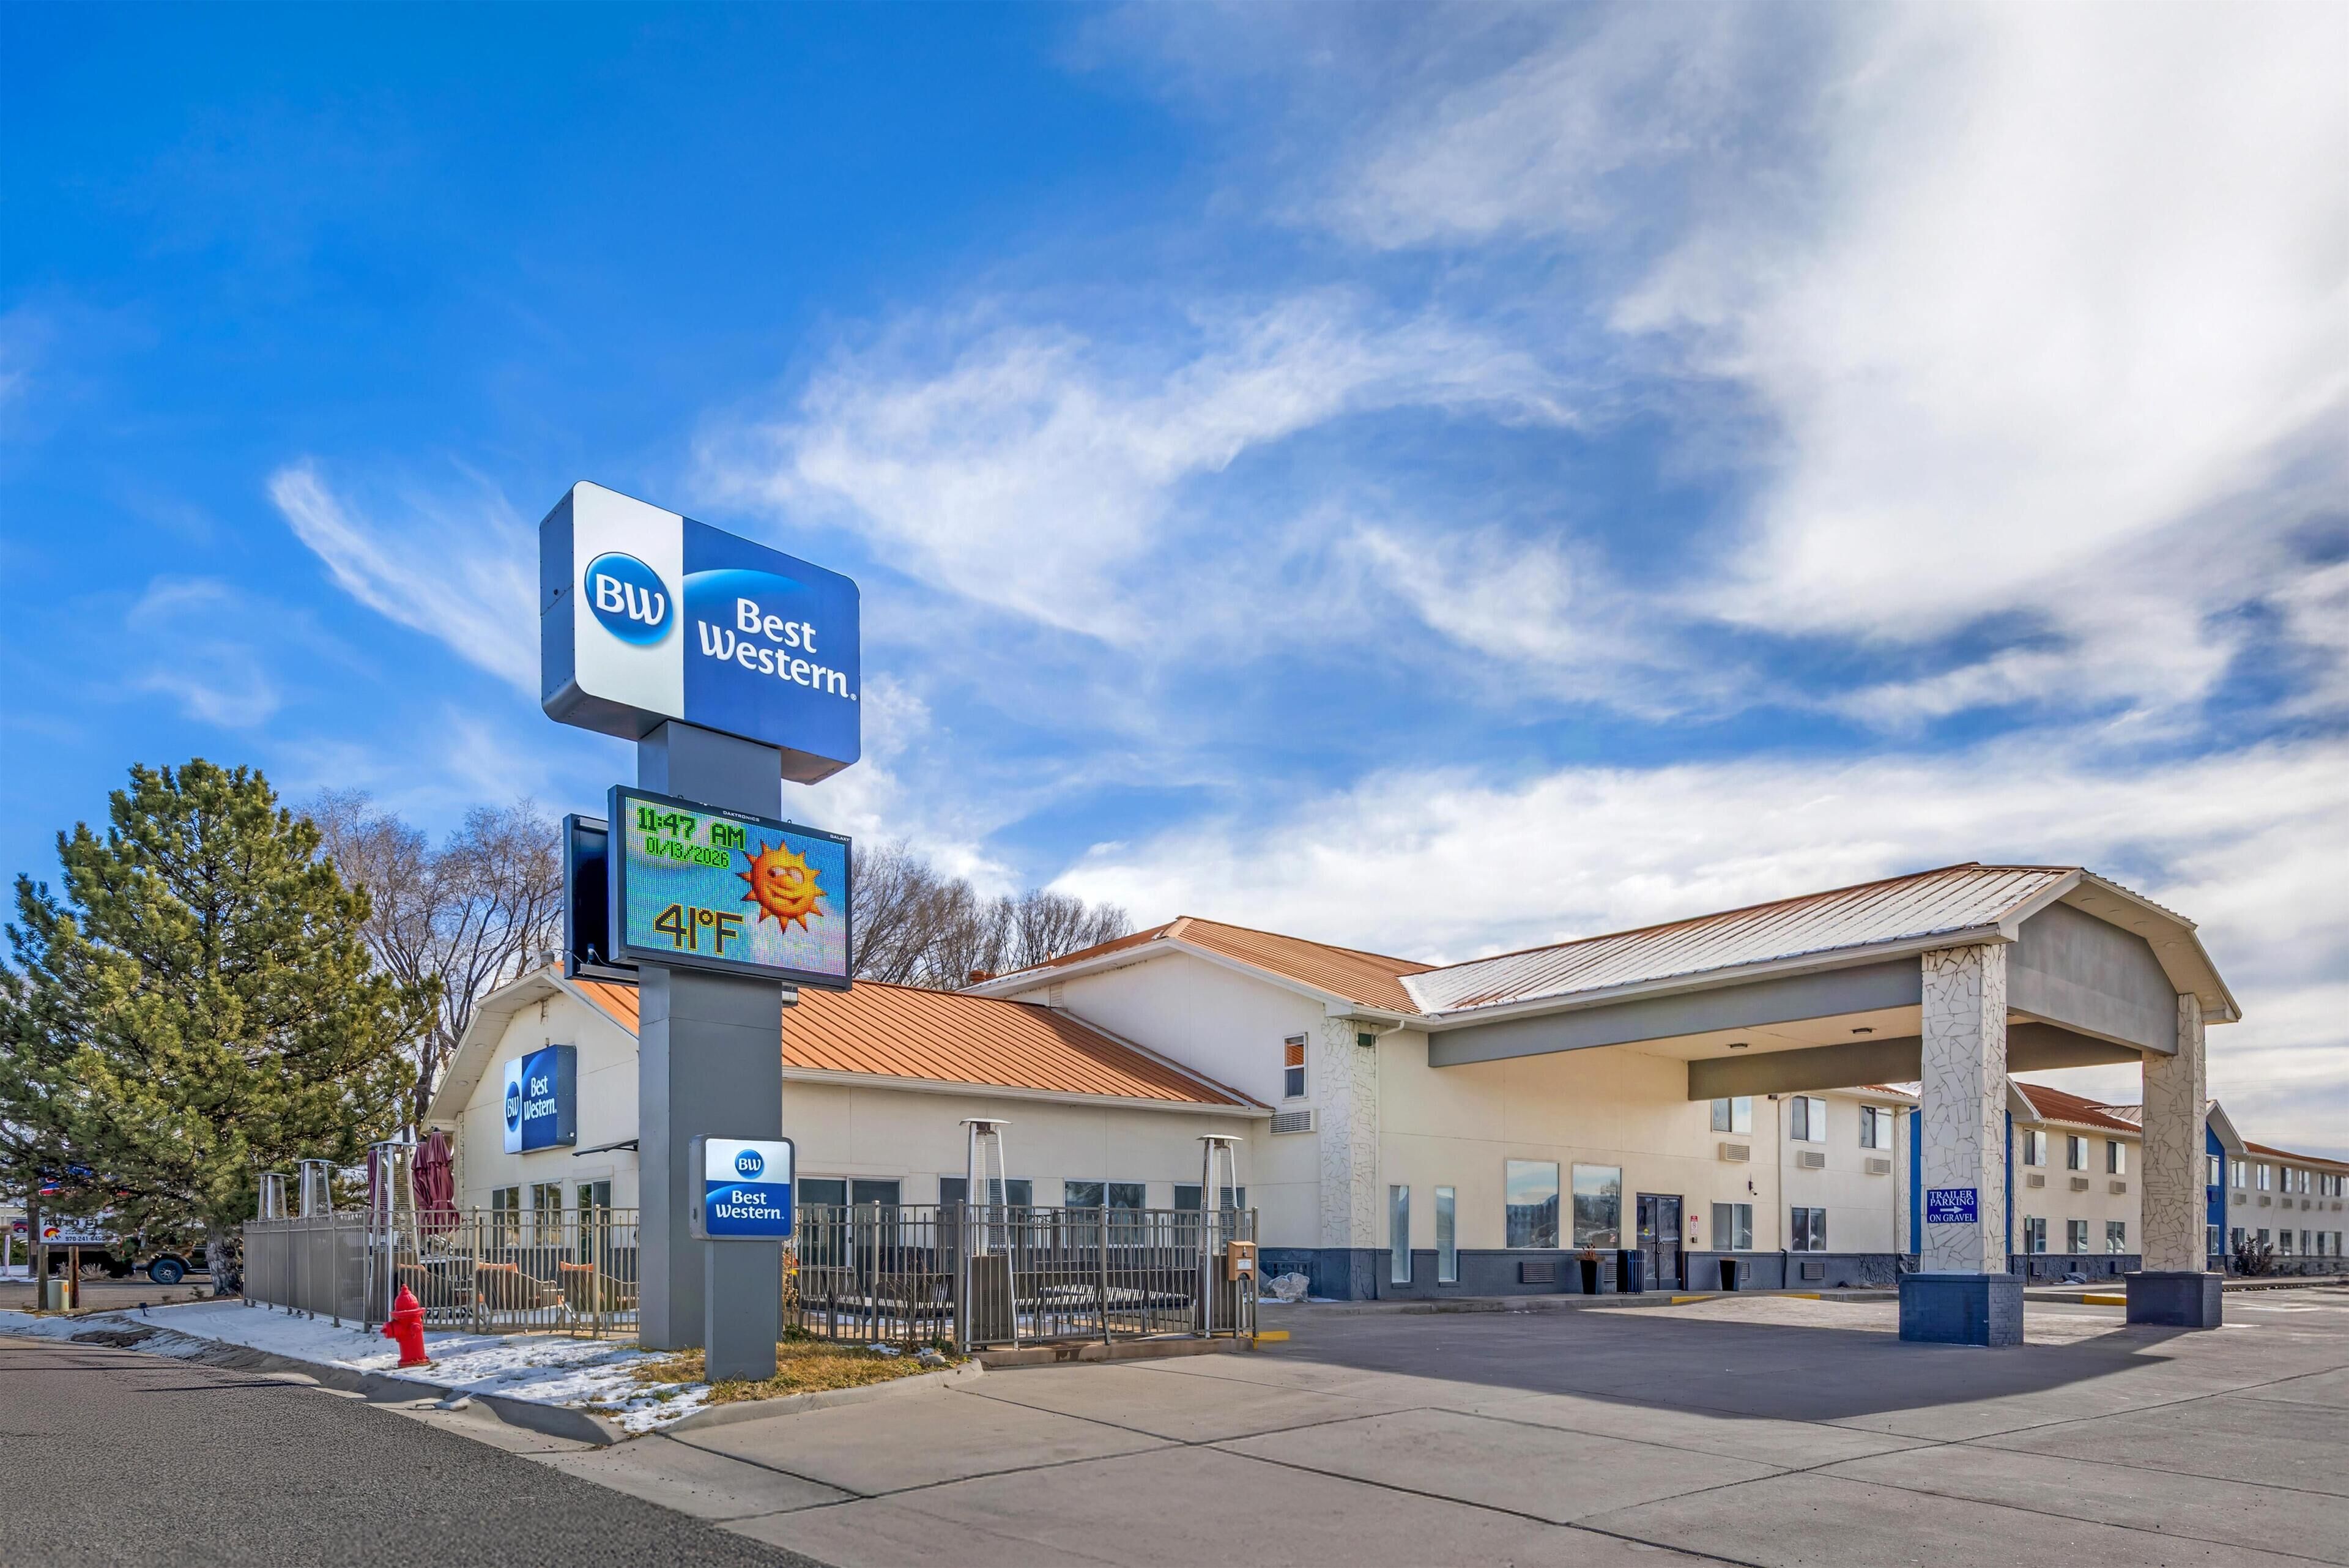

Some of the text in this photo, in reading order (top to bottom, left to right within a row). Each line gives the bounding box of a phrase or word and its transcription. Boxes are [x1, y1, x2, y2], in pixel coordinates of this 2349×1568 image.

[595, 573, 665, 625] BW
[737, 597, 817, 653] Best
[722, 810, 760, 822] DAKTRONICS
[637, 807, 744, 850] 11:47 AM
[646, 836, 729, 868] 01/13/2026
[654, 904, 743, 954] 41°F
[530, 1075, 548, 1098] Best
[507, 1096, 519, 1118] BW
[738, 1158, 762, 1171] BW
[732, 1190, 767, 1205] Best
[1929, 1190, 1973, 1199] TRAILER
[1930, 1197, 1974, 1206] PARKING
[1929, 1213, 1975, 1222] ON GRAVEL
